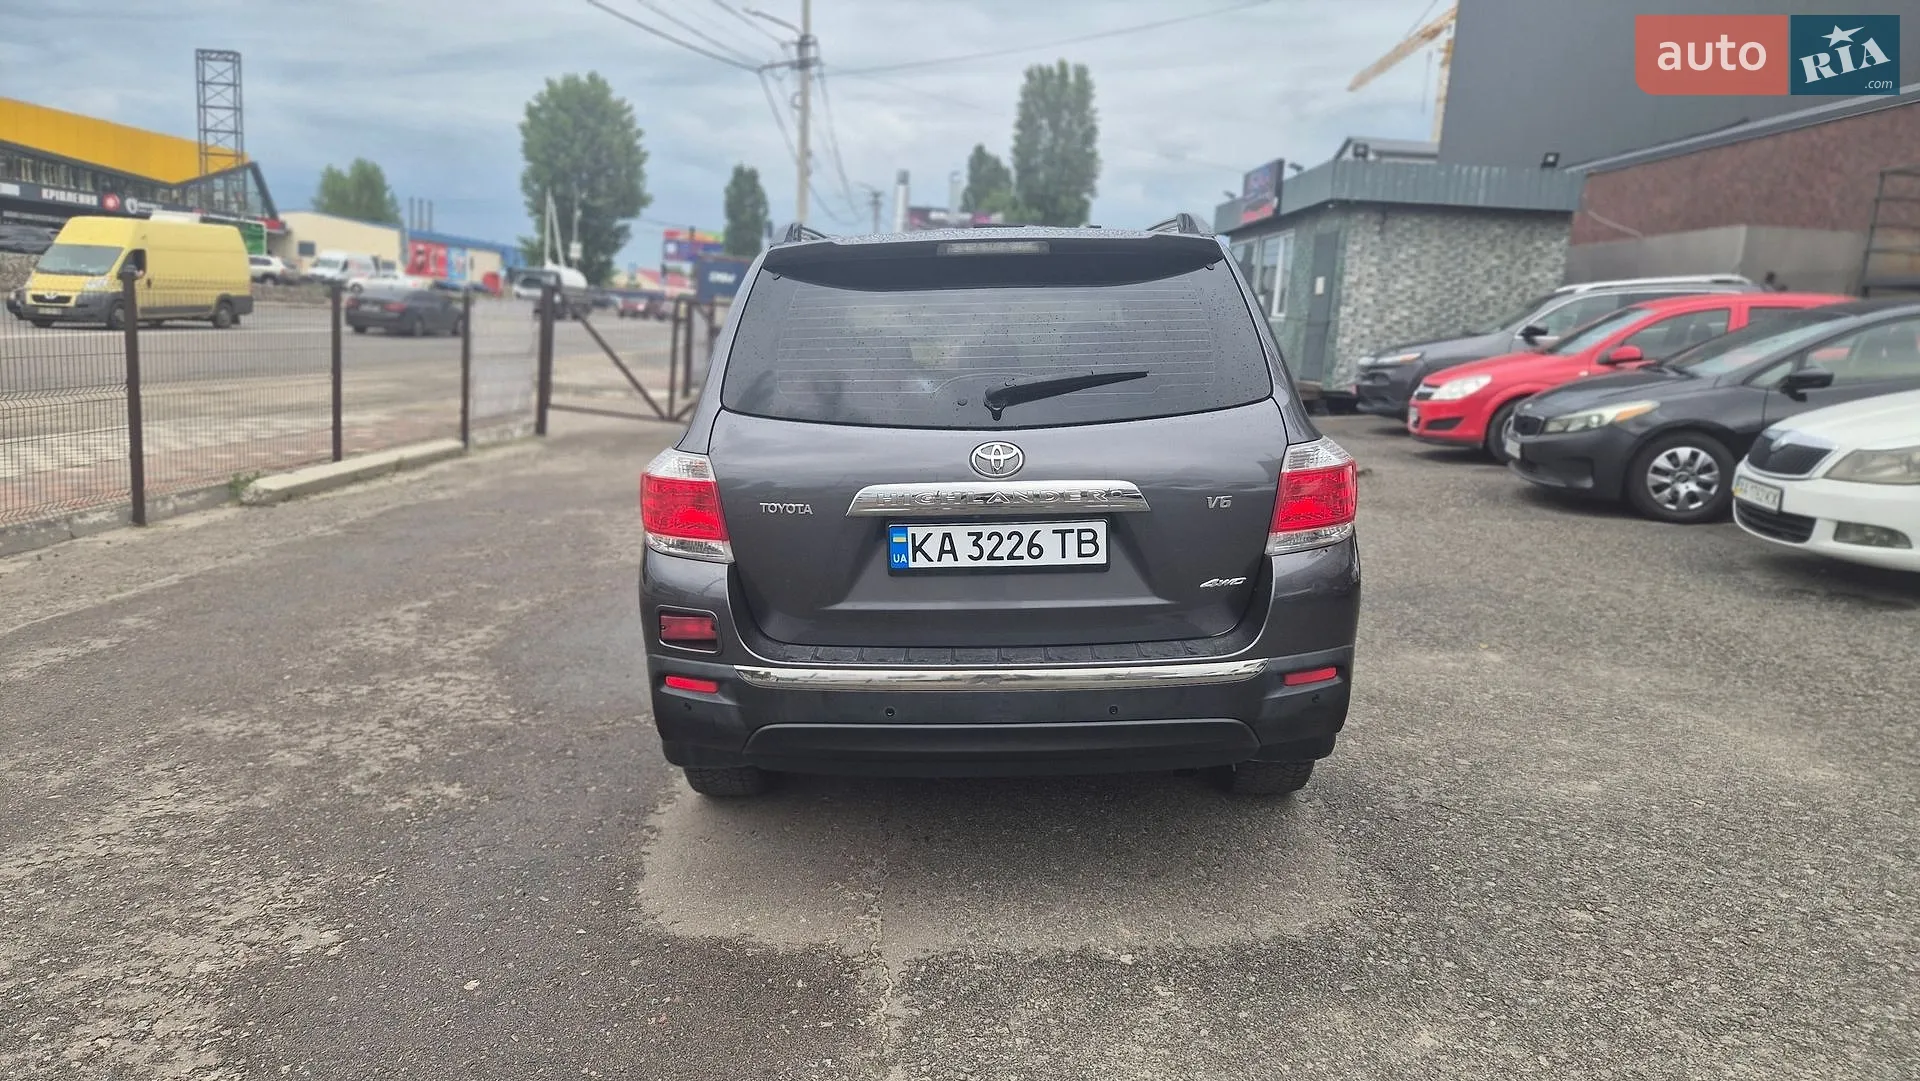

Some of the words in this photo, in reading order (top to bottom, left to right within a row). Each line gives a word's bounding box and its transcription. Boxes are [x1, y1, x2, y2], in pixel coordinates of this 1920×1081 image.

[877, 489, 1108, 505] HIGHLANDER
[1206, 495, 1232, 509] V6
[759, 502, 813, 515] TOYOTA
[911, 532, 959, 562] KA
[967, 529, 1044, 562] 3226
[1052, 528, 1100, 559] TB
[893, 553, 907, 564] UA
[1200, 577, 1246, 588] 4WD
